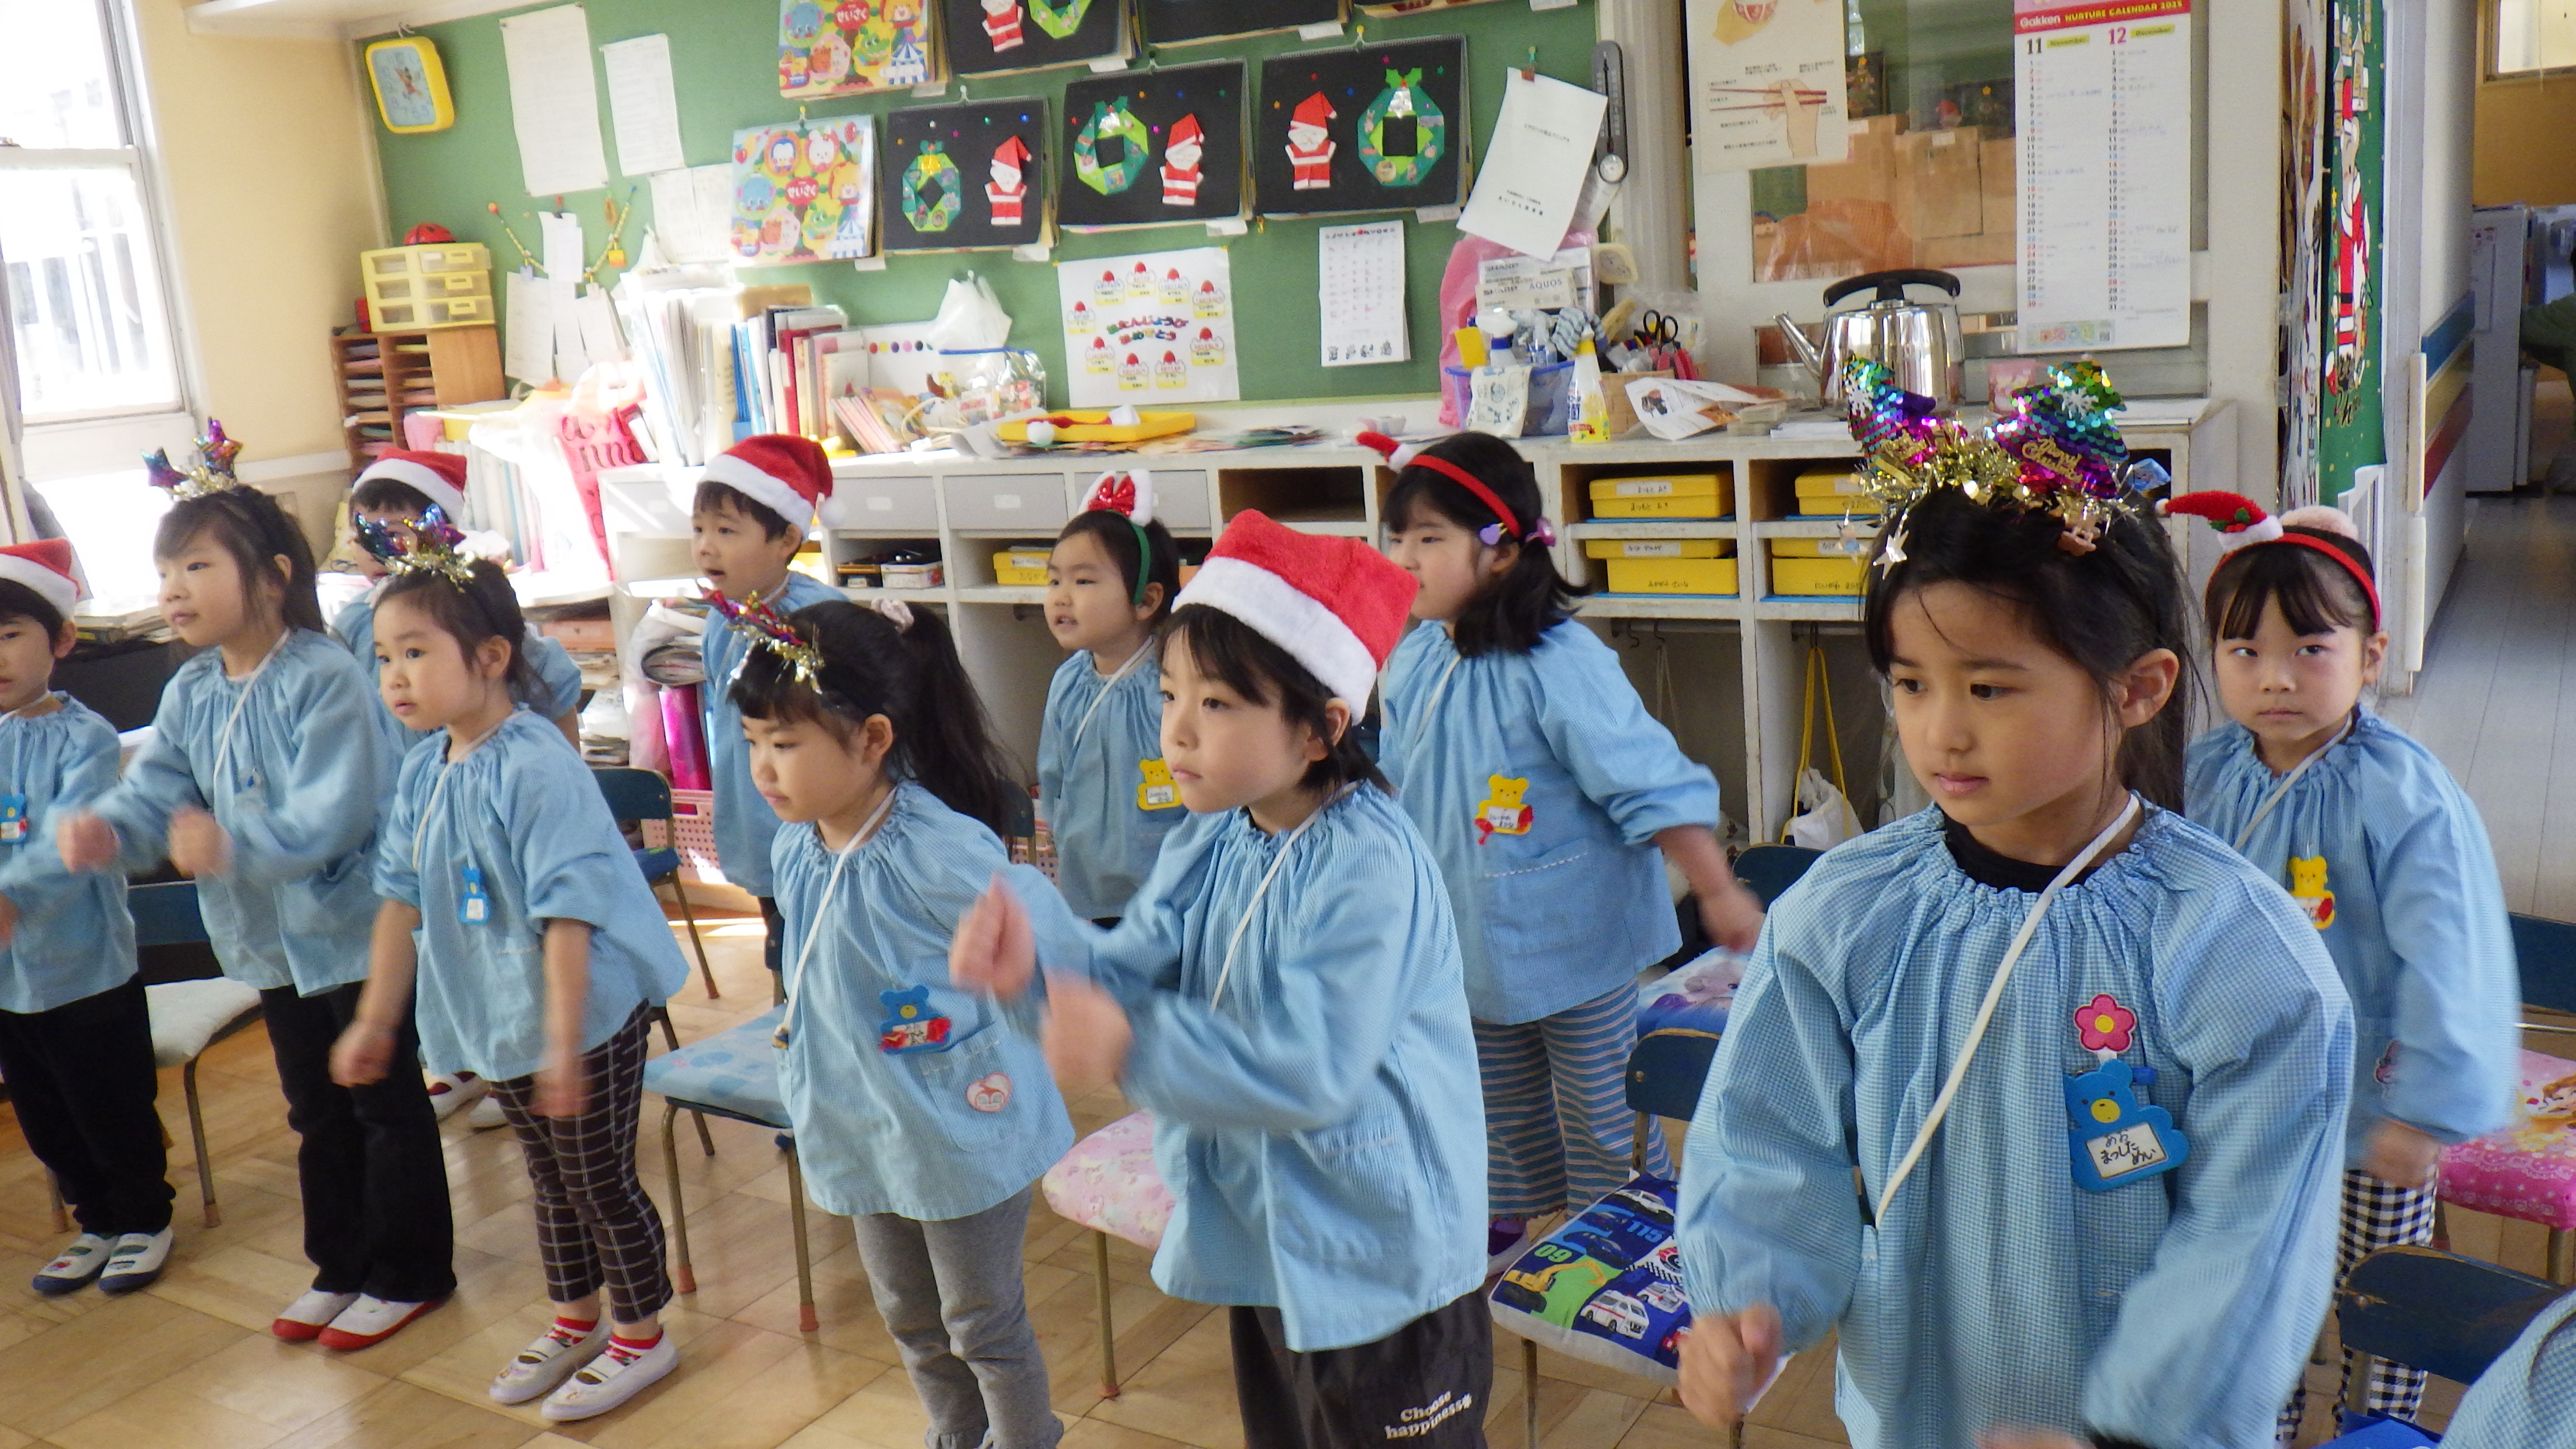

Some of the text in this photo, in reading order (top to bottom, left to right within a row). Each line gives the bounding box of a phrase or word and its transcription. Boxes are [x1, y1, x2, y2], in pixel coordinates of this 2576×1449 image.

[836, 8, 867, 23] せいさく
[2019, 14, 2061, 29] Gakken
[2064, 9, 2106, 22] NURTURE
[2109, 3, 2158, 17] CALENDAR
[2108, 26, 2172, 45] 12 December
[2026, 37, 2086, 55] 11 November
[787, 184, 816, 198] せいさく
[1483, 285, 1518, 296] SHARP
[1528, 278, 1563, 290] AQUOS
[1400, 1390, 1452, 1422] Choose
